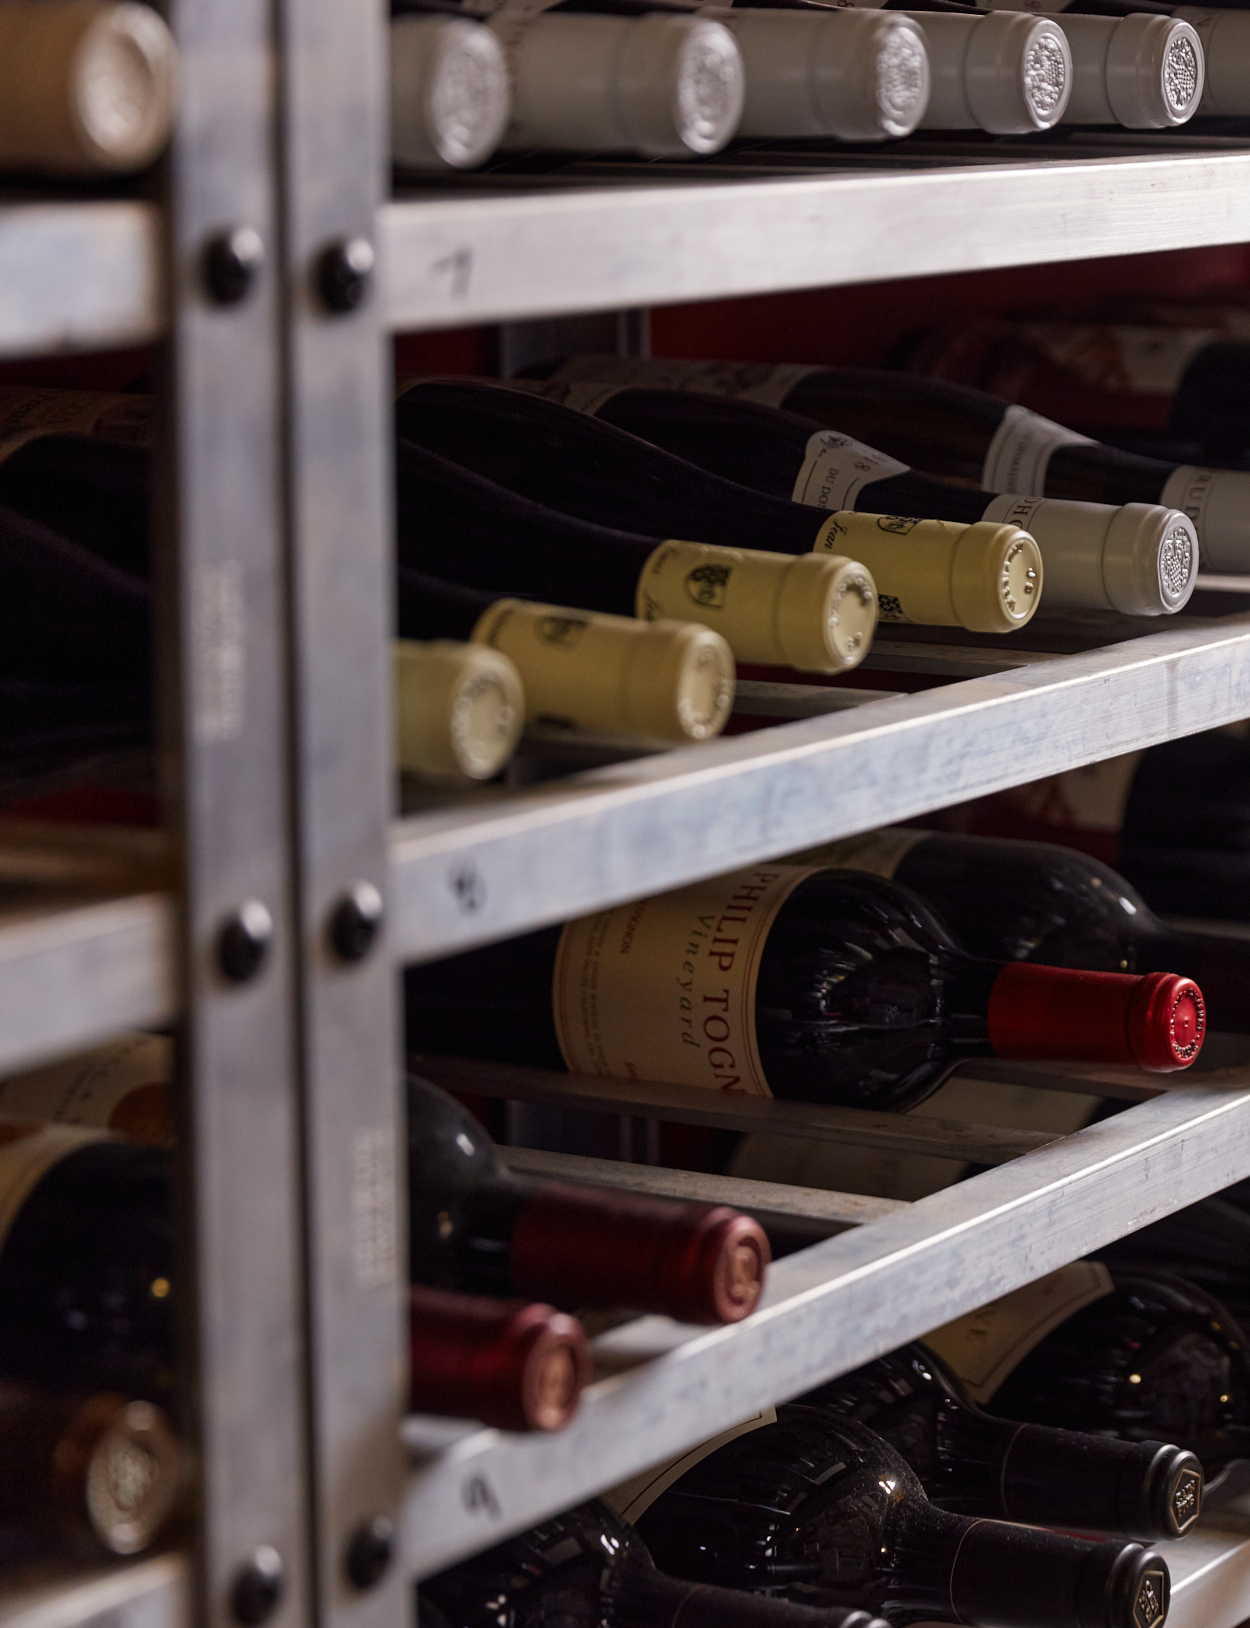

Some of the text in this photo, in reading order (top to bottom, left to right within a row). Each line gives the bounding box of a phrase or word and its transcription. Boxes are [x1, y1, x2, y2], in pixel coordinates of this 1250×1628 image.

[825, 467, 839, 485] DU
[824, 518, 848, 550] Jean
[708, 872, 779, 972] PHILIP
[676, 914, 714, 1048] Vineyard
